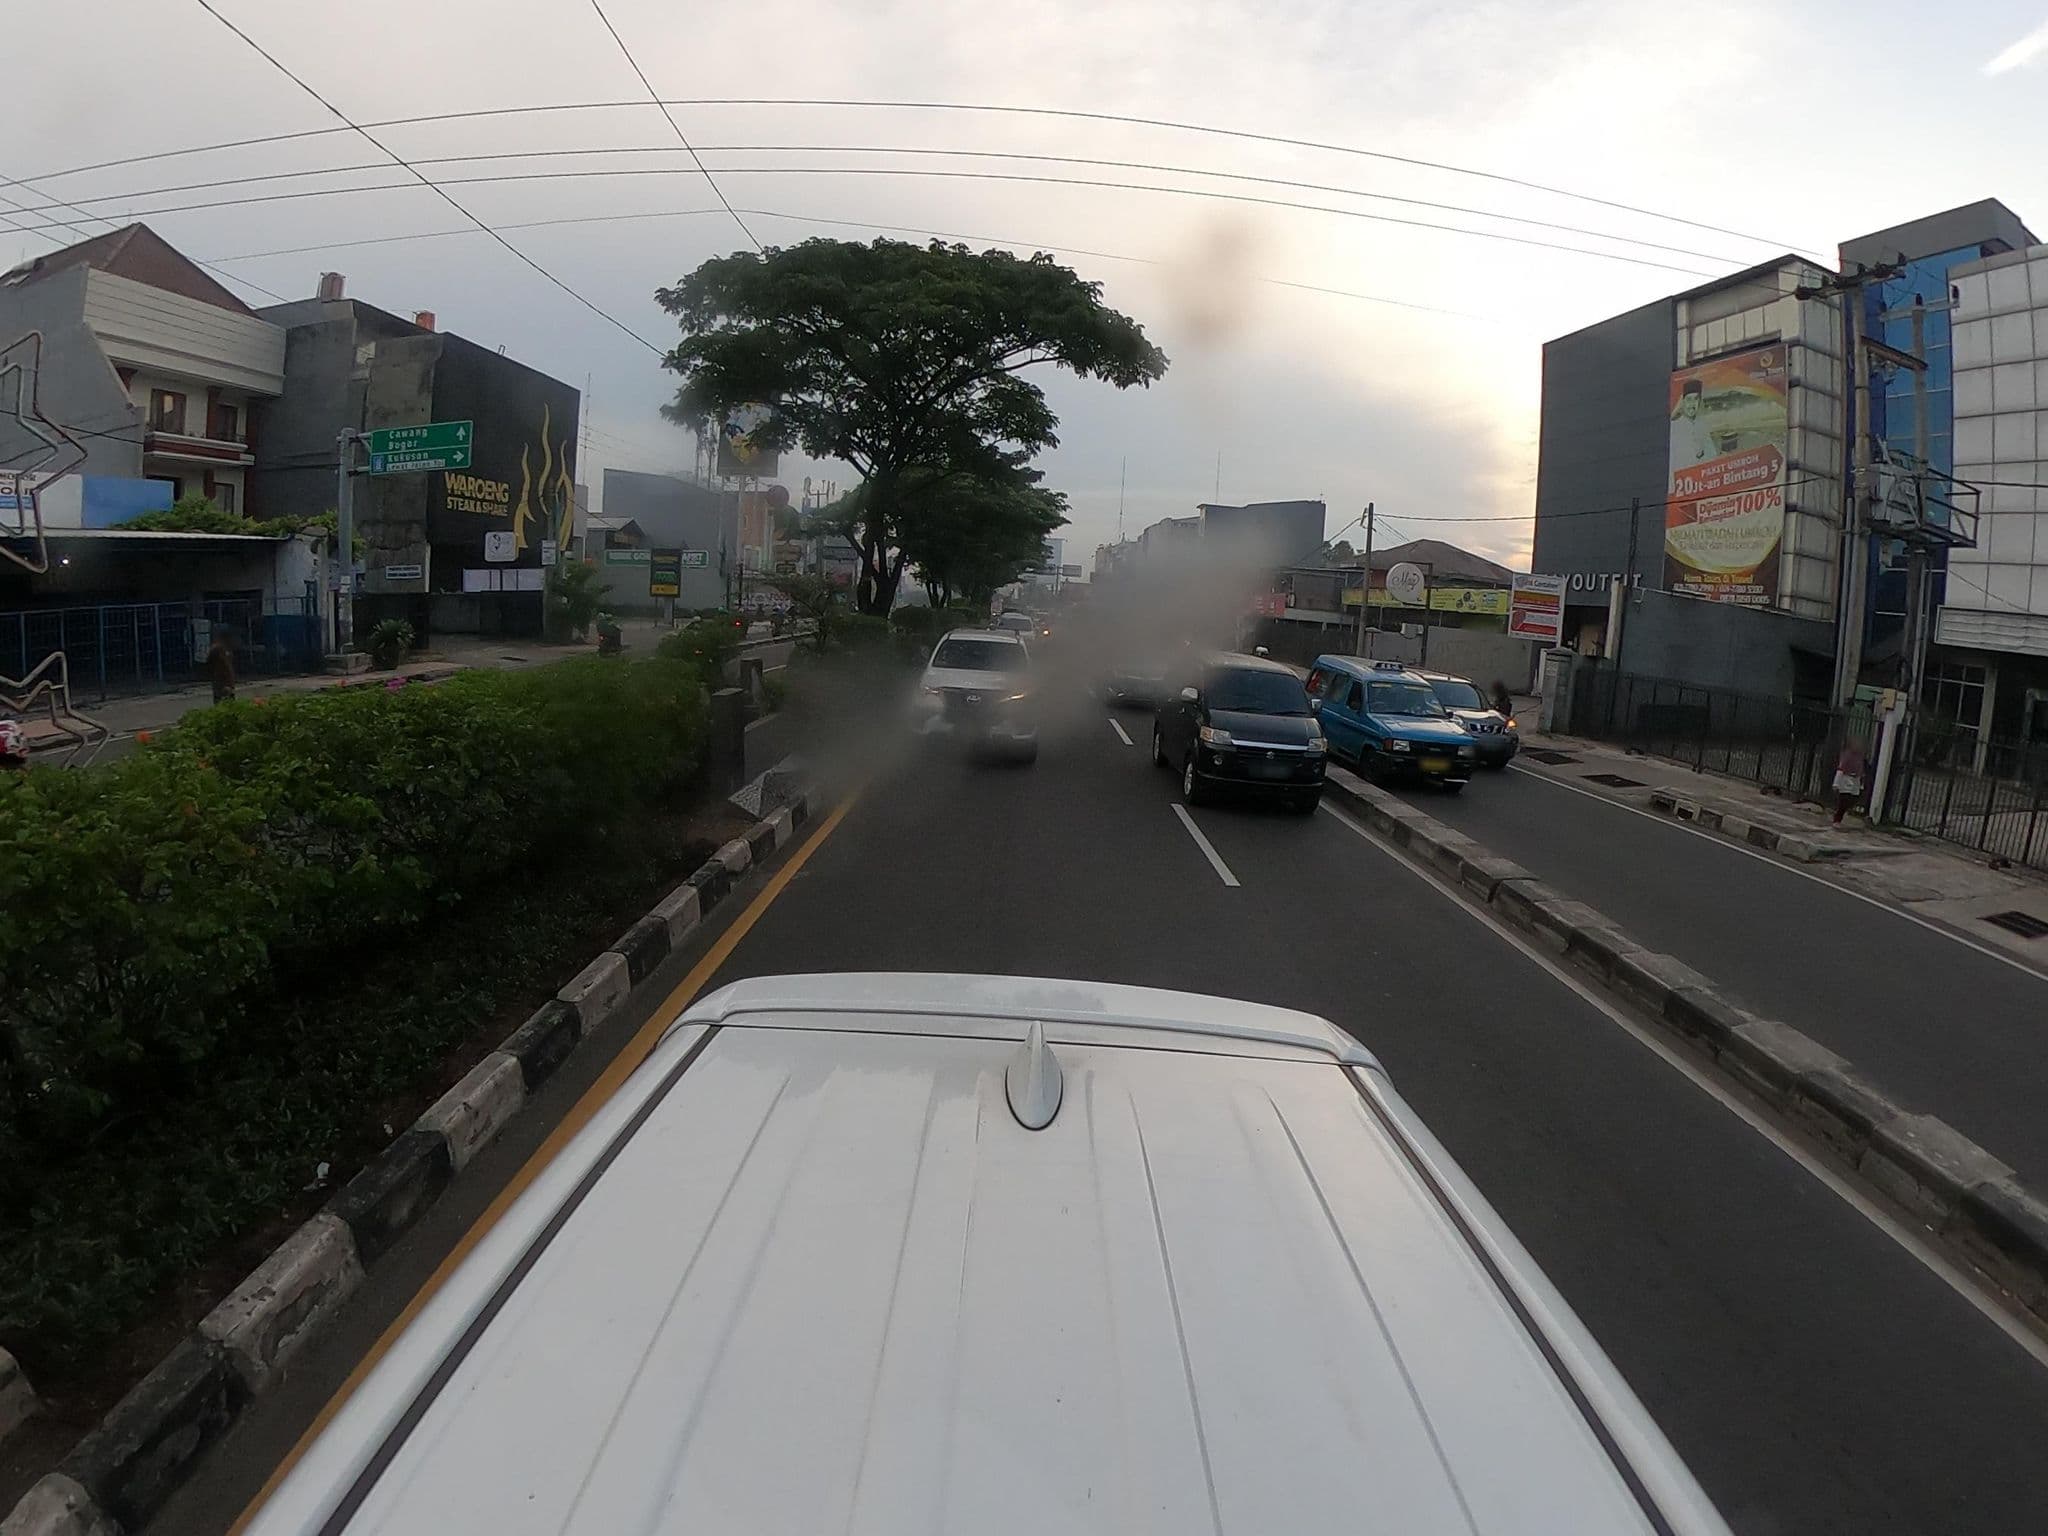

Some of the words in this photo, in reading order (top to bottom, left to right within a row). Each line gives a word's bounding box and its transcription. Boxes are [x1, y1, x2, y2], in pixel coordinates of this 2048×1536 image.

[388, 428, 428, 439] Cawang
[388, 440, 418, 451] Bogor
[1723, 464, 1768, 486] Bintang
[445, 471, 509, 503] WAROENG
[1734, 487, 1782, 516] 100%
